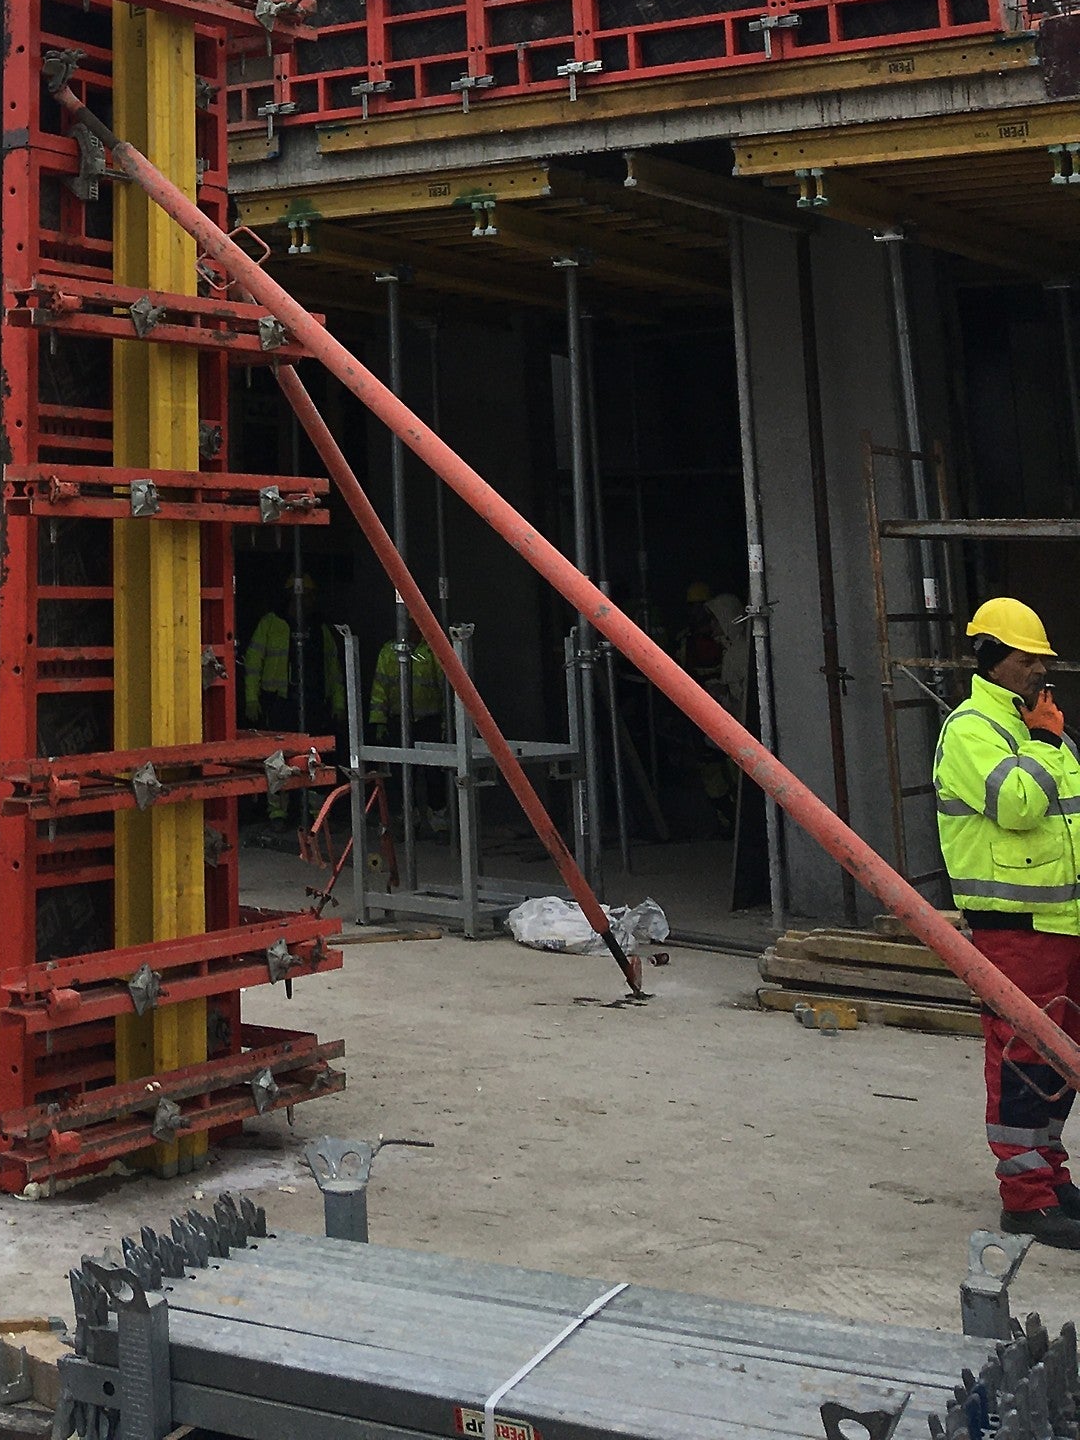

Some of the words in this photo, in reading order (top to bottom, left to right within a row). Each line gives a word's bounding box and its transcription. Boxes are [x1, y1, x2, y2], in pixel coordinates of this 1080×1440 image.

[999, 124, 1026, 138] PERI
[428, 185, 448, 198] PERI
[496, 1423, 526, 1440] PERI
